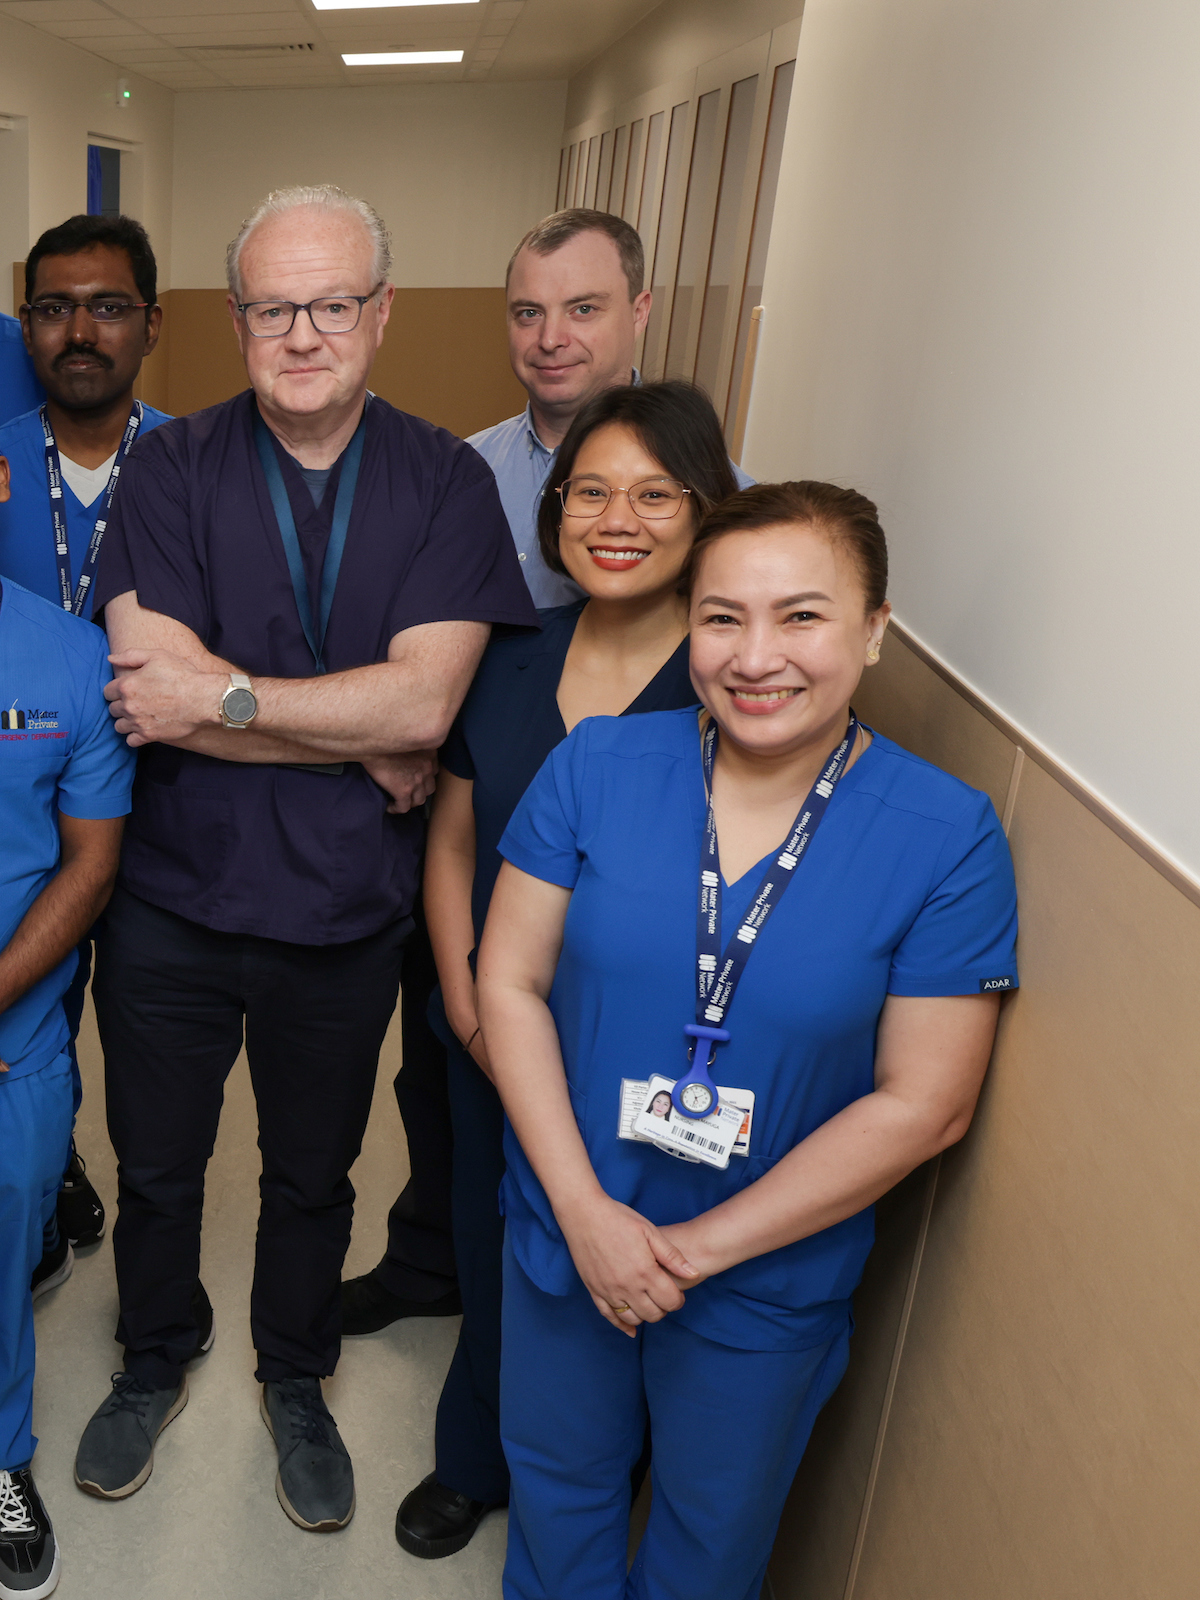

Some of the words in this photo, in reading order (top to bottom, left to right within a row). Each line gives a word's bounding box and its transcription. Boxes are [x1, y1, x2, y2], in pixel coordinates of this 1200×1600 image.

[96, 532, 104, 547] Mater
[90, 546, 99, 564] Private
[28, 709, 58, 719] Mater
[28, 720, 58, 729] Private
[31, 731, 69, 740] DEPARTMENT
[823, 760, 837, 780] Mater
[834, 740, 848, 760] Private
[785, 833, 800, 853] Mater
[794, 811, 812, 833] Private
[793, 832, 810, 856] Network
[701, 887, 709, 913] Network
[709, 888, 718, 909] Mater
[745, 904, 760, 925] Mater
[756, 882, 774, 906] Private
[708, 909, 717, 934] Private
[752, 903, 772, 928] Network
[699, 972, 707, 998] Network
[710, 983, 723, 1005] Mater
[718, 959, 734, 983] Private
[984, 979, 1010, 990] ADAR
[718, 981, 733, 1008] Network
[722, 1112, 739, 1122] Private
[724, 1107, 739, 1116] Mater
